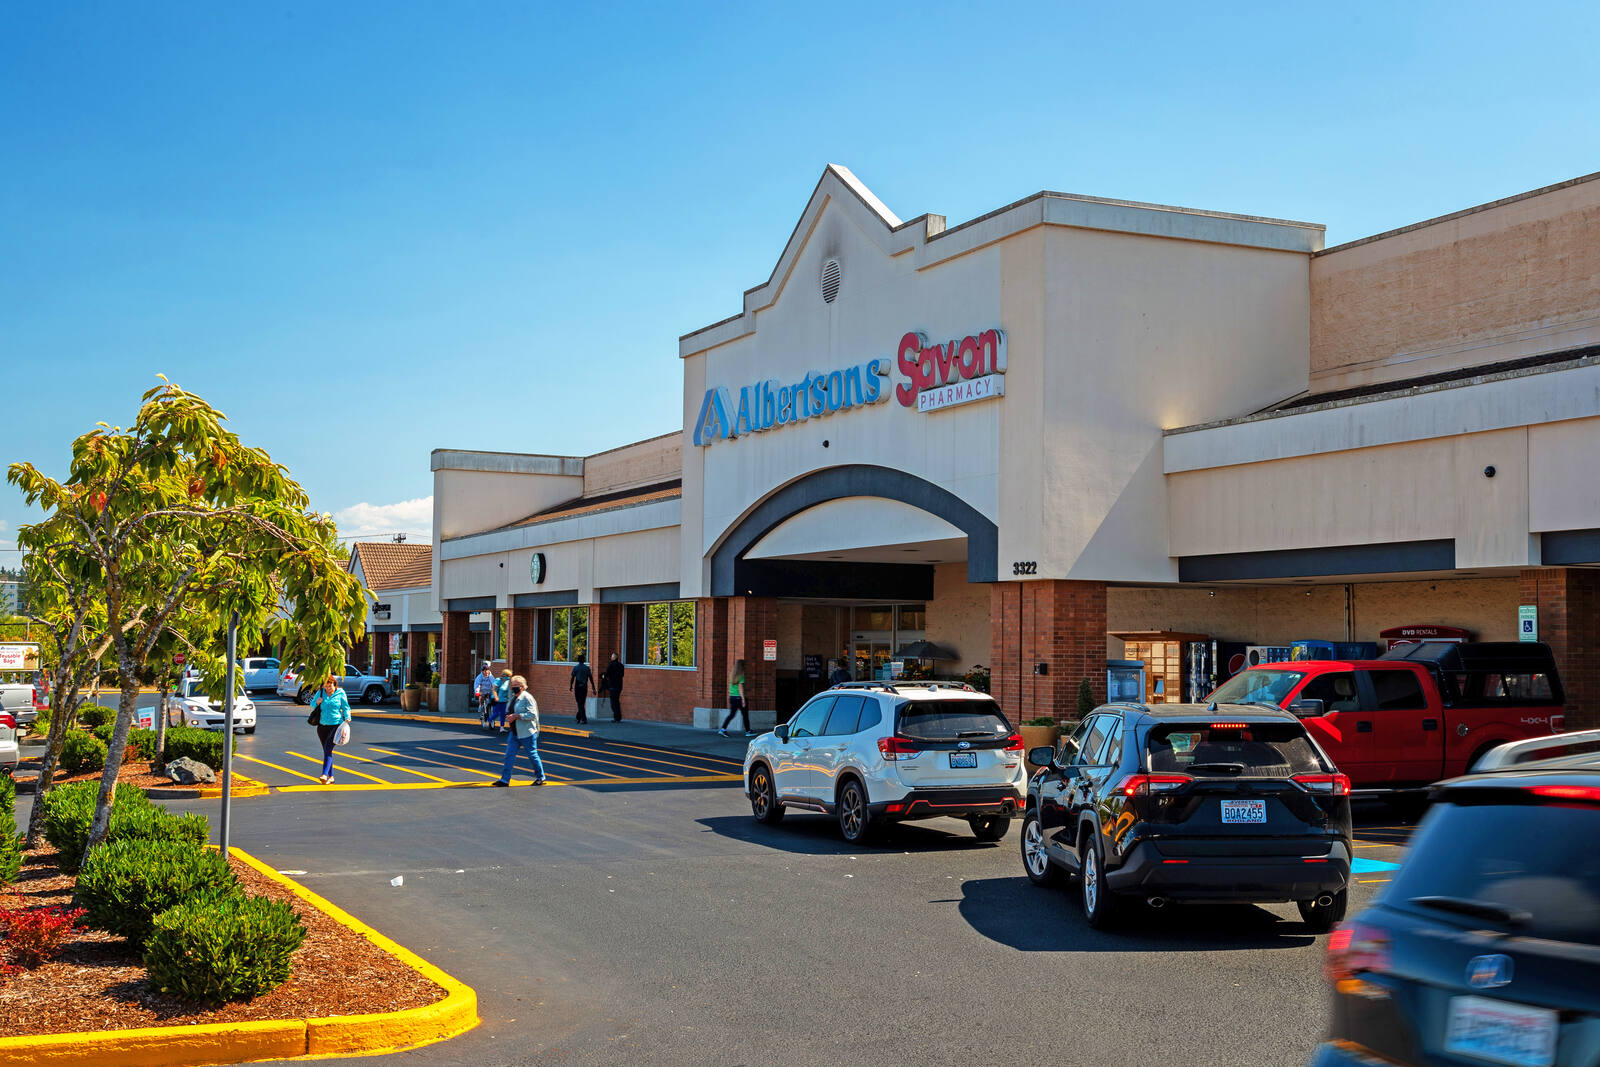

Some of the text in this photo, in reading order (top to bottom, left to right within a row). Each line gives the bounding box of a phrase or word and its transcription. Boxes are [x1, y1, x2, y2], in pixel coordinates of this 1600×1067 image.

[735, 359, 882, 435] Albertsons
[920, 378, 991, 409] PHARMACY
[1013, 561, 1037, 575] 3322
